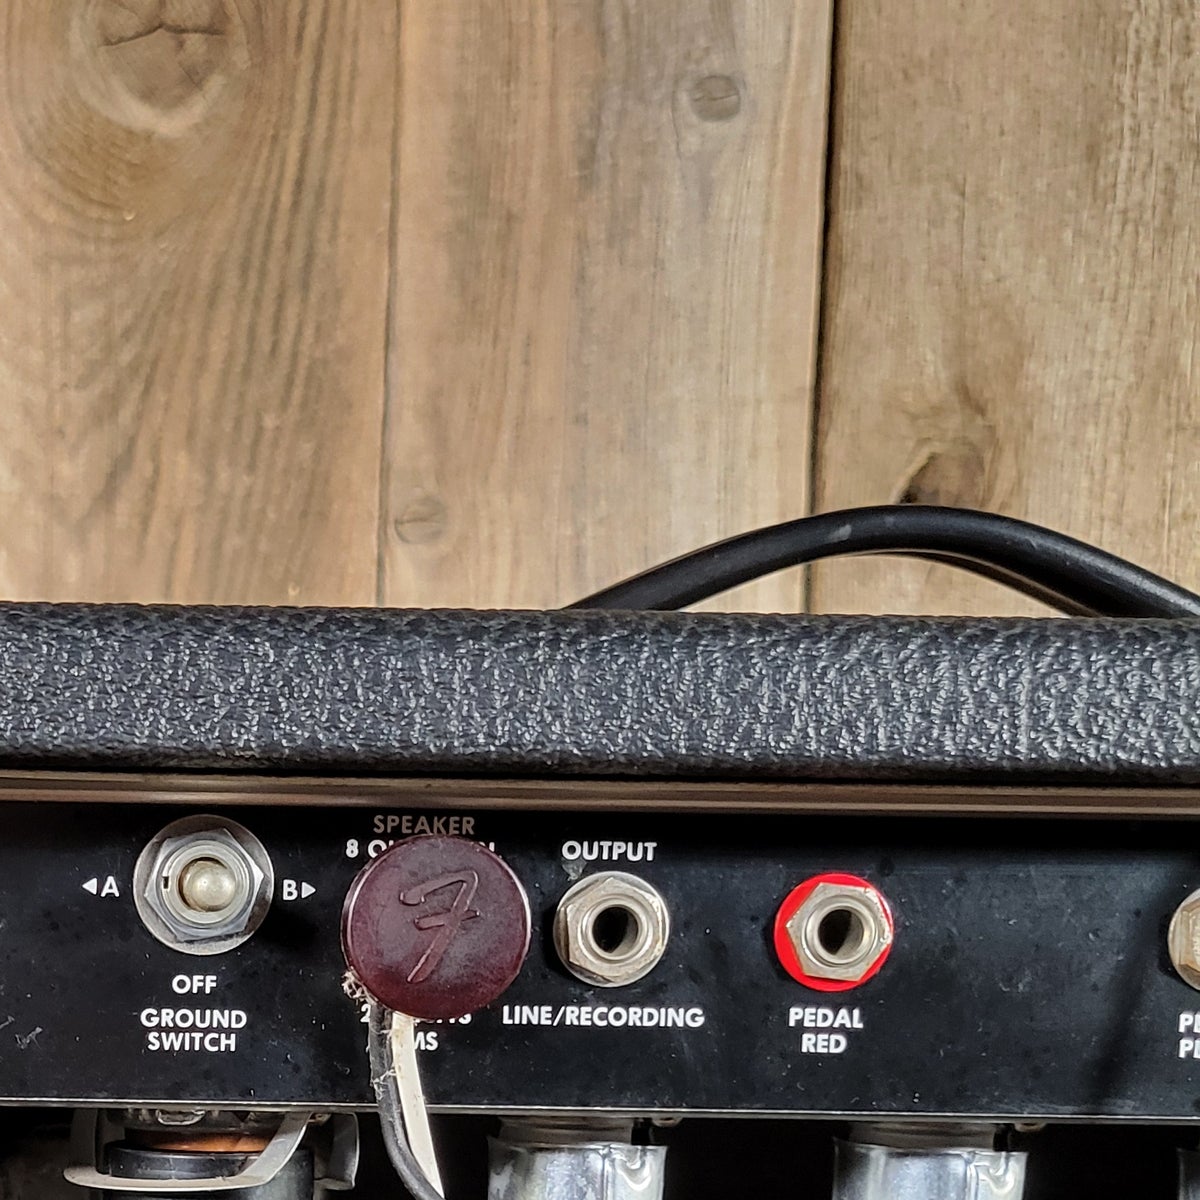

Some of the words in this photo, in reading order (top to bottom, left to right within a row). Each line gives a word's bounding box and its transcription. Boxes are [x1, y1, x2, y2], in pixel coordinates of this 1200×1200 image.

[373, 815, 476, 835] SPEAKER
[345, 838, 360, 859] 8
[561, 841, 658, 862] OUTPUT
[100, 875, 120, 898] A
[282, 879, 298, 901] B
[171, 974, 218, 995] OFF
[140, 1008, 248, 1031] GROUND
[502, 1004, 705, 1029] LINE/RECORDING
[787, 1008, 864, 1030] PEDAL
[146, 1031, 237, 1052] SWITCH
[800, 1033, 848, 1055] RED
